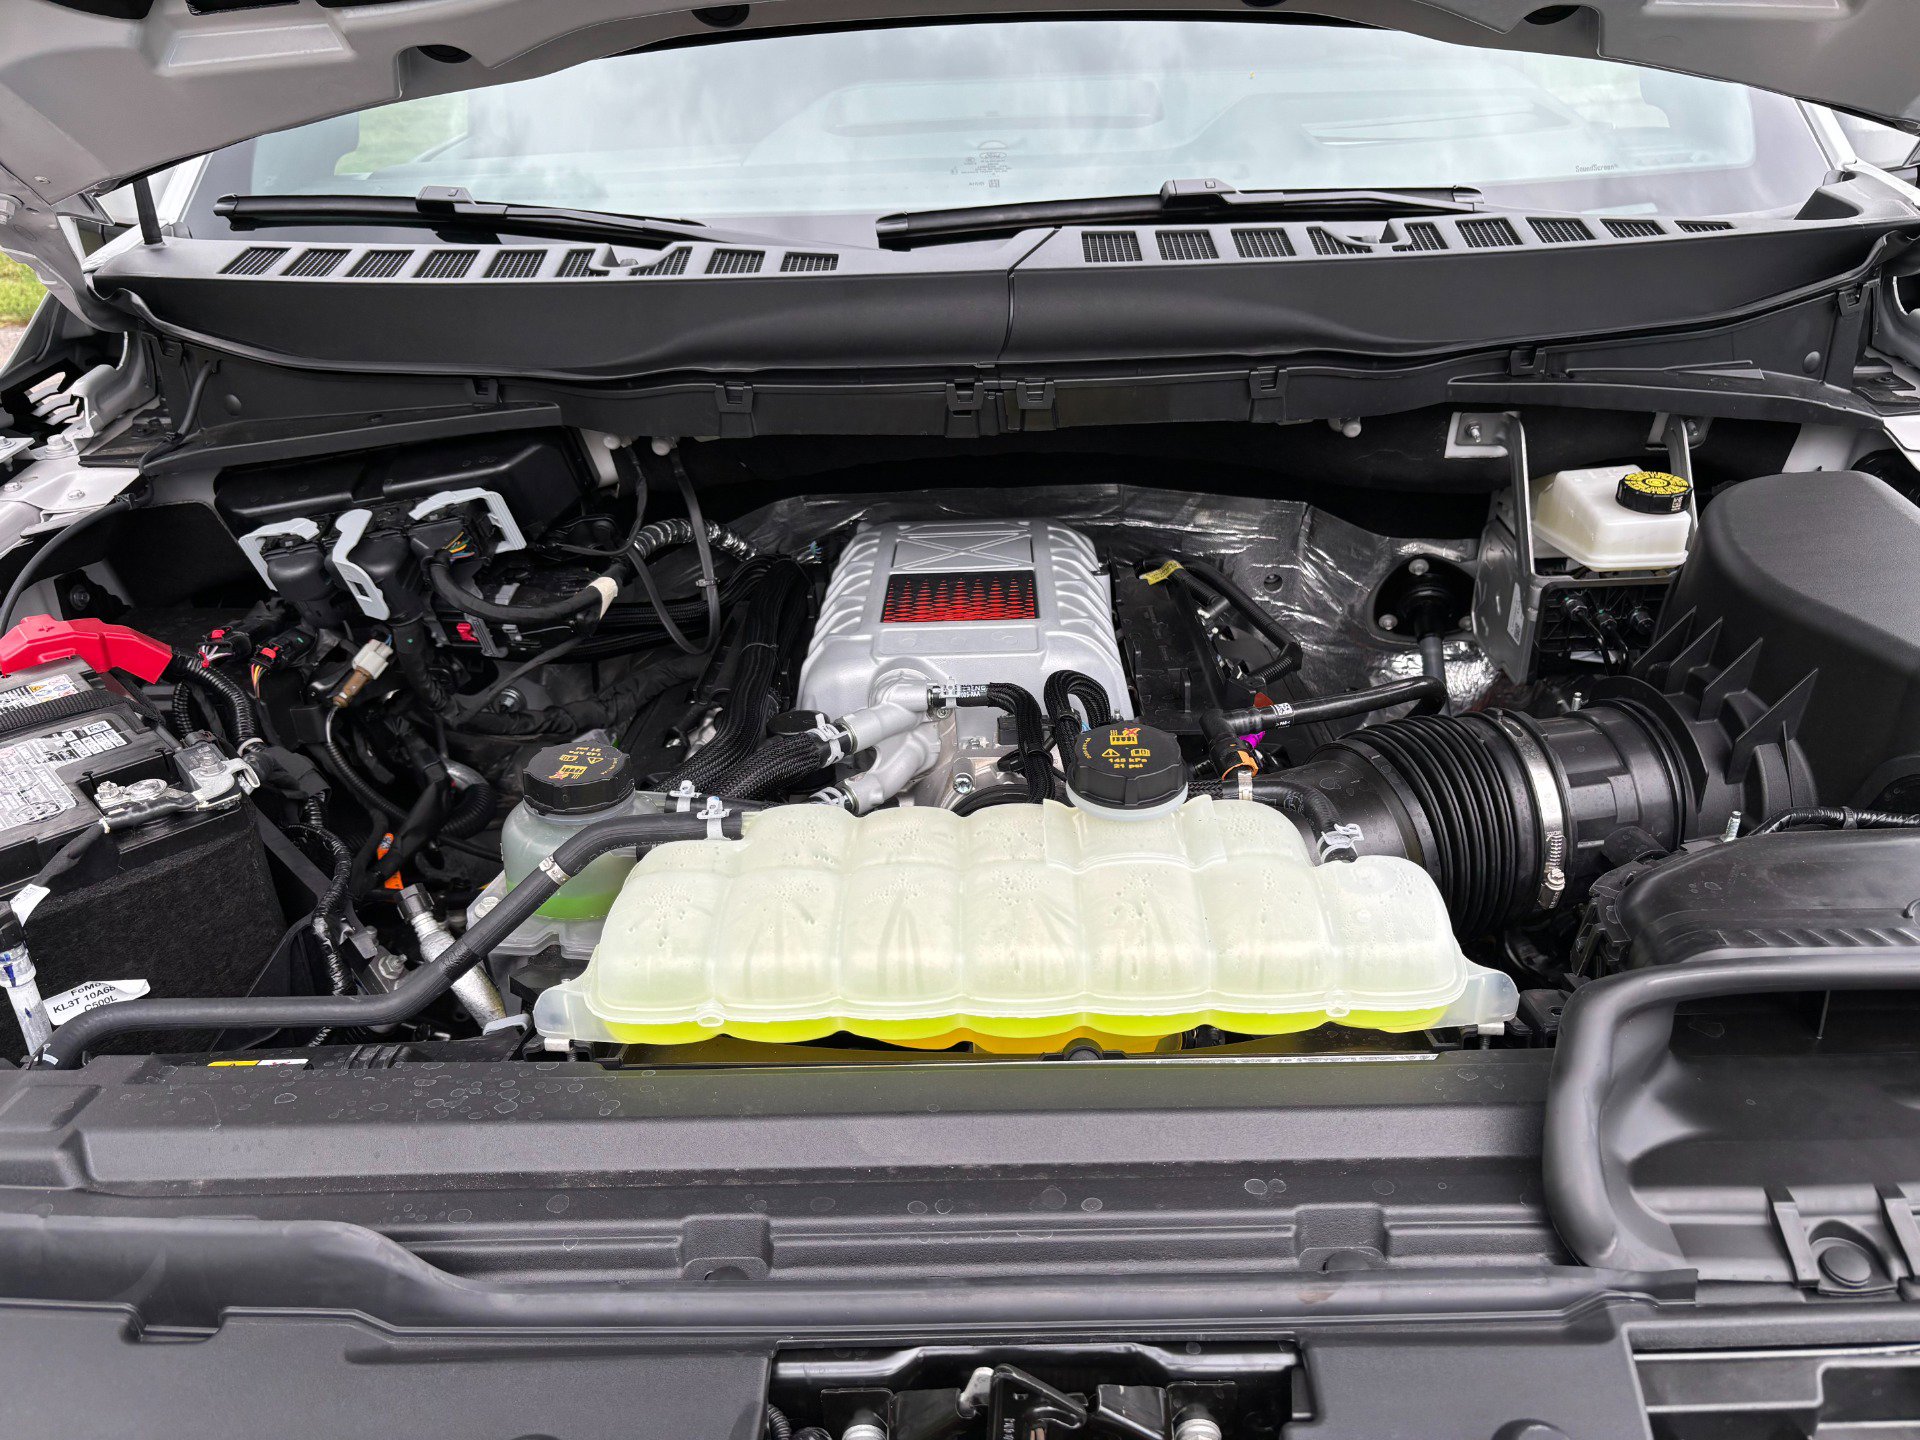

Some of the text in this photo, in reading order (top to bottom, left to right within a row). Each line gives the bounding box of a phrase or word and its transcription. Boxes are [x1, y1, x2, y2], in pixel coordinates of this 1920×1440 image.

[70, 982, 104, 996] FoMo
[53, 998, 81, 1013] KL3T
[84, 994, 118, 1012] C500L
